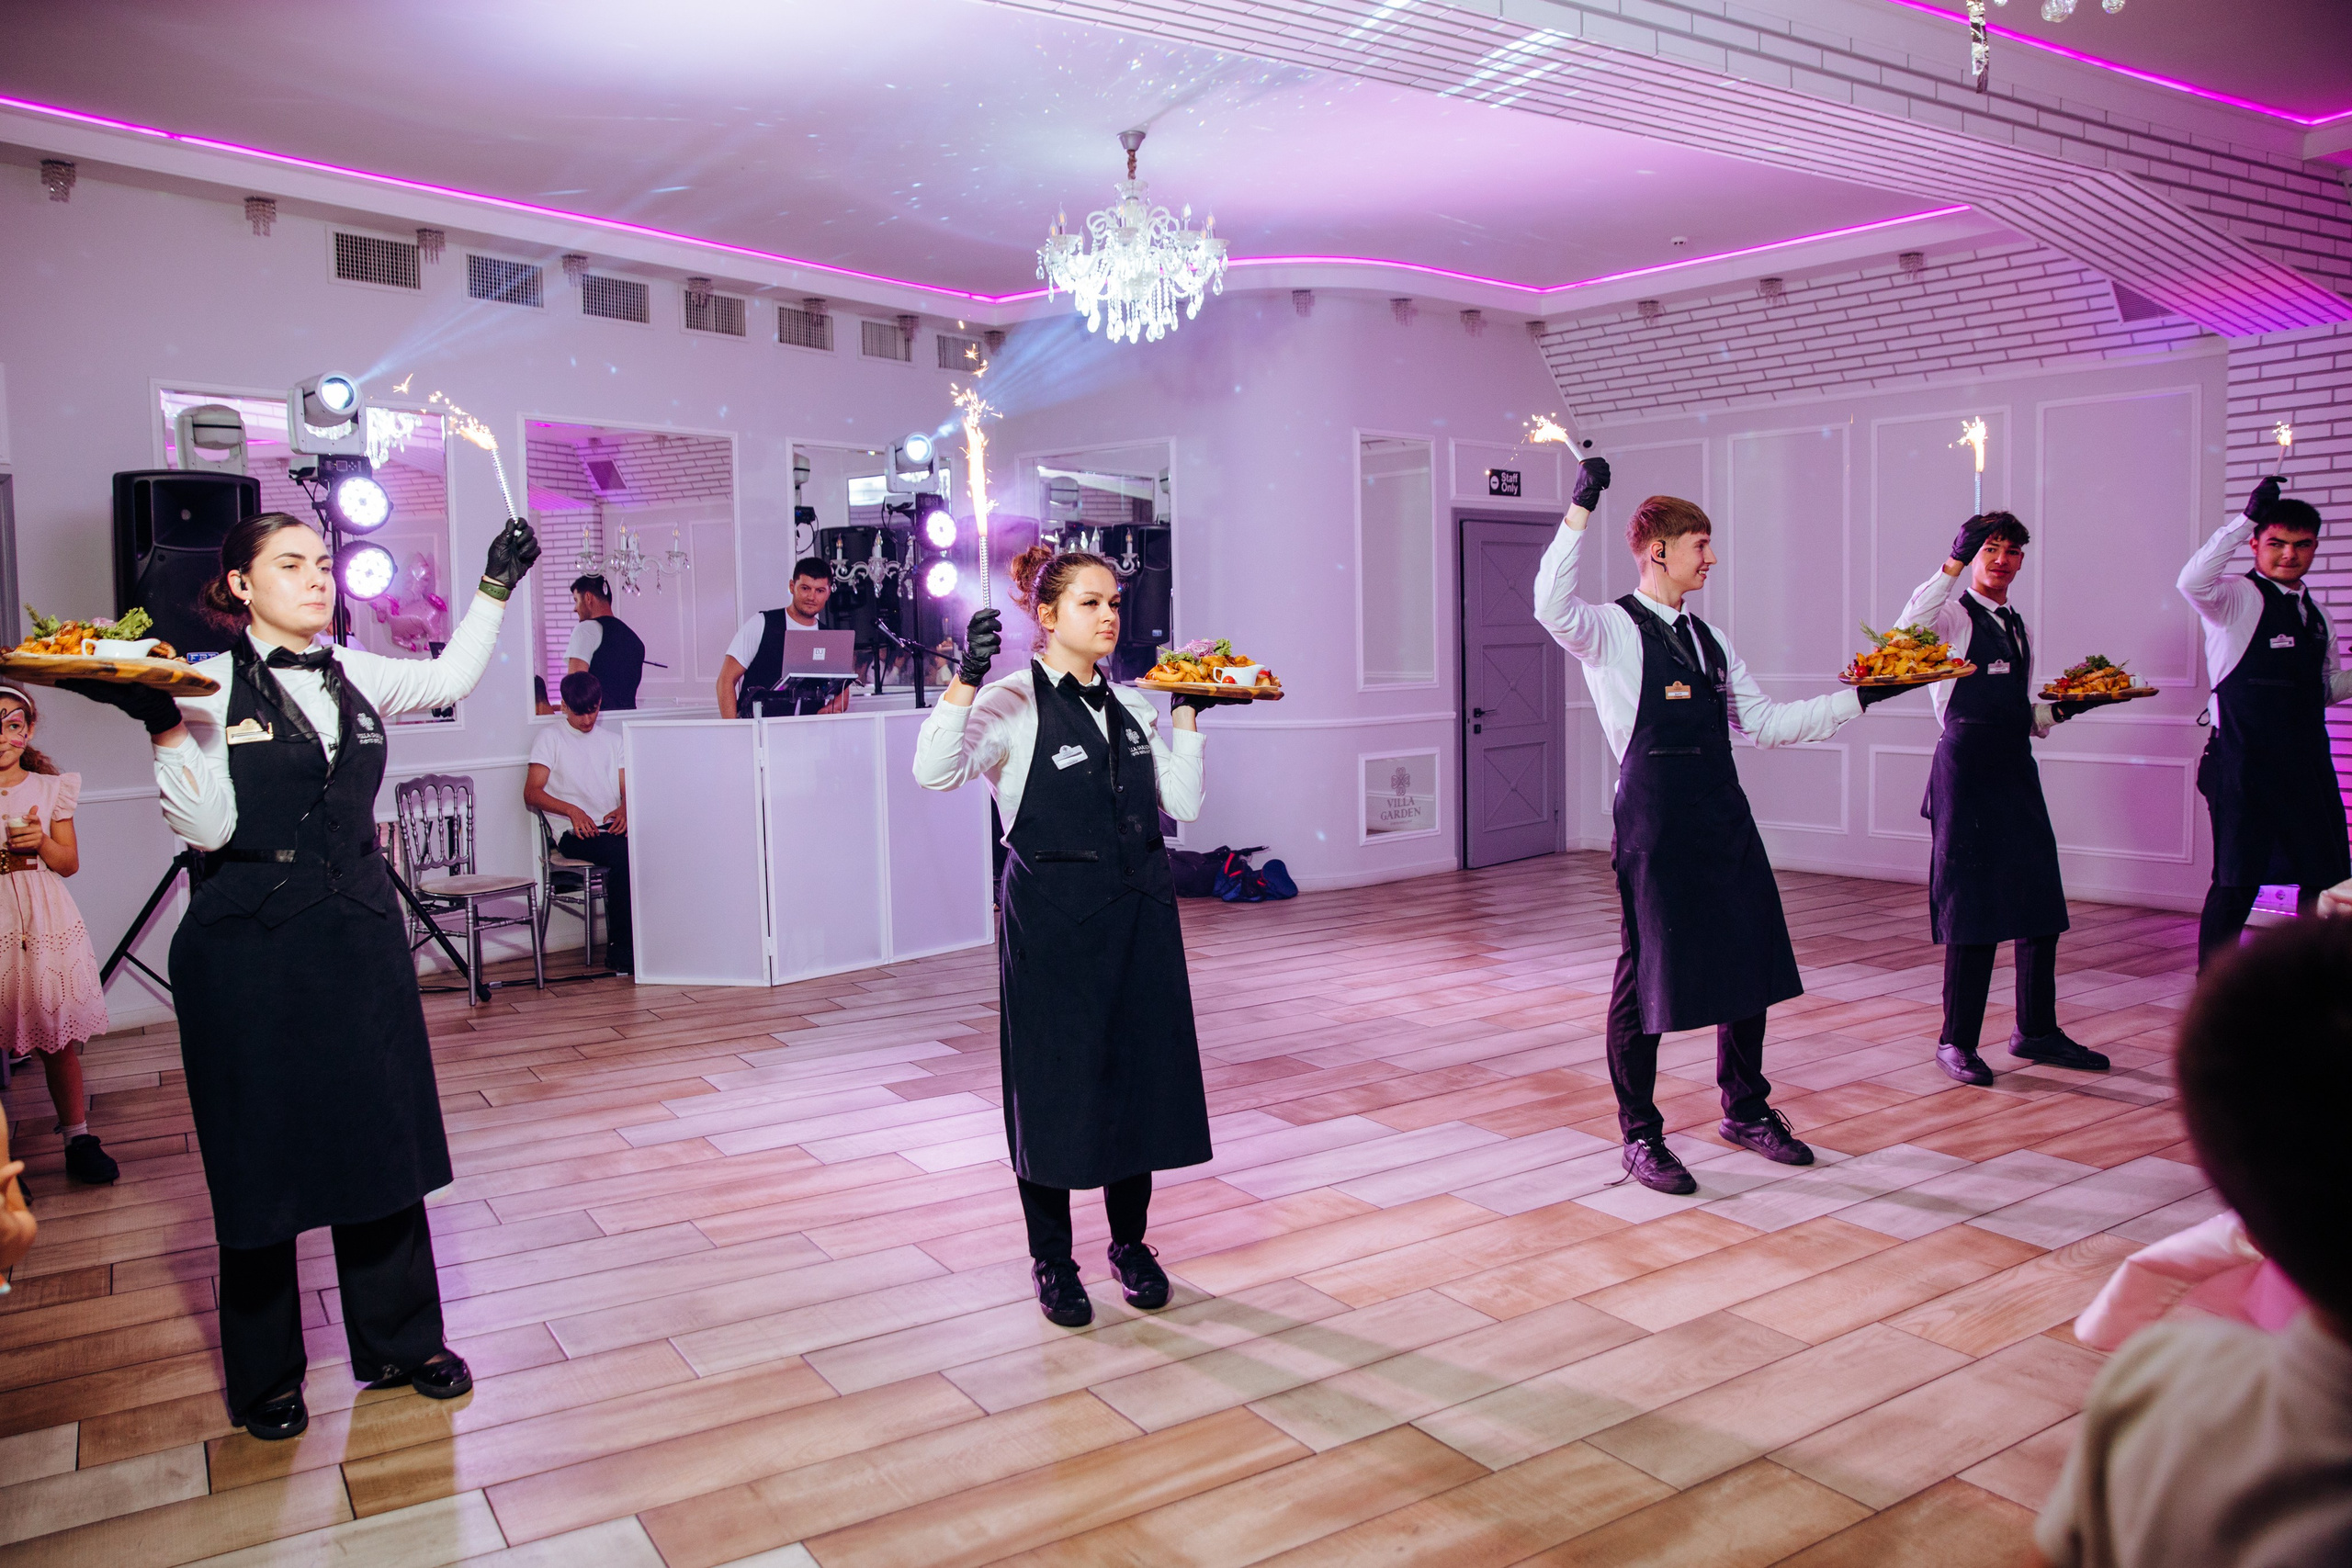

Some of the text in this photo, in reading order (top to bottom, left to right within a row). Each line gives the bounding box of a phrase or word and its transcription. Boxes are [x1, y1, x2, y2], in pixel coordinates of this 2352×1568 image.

[1501, 472, 1518, 483] Staff
[1501, 481, 1518, 495] Only
[1386, 796, 1415, 807] VILLA
[1380, 807, 1421, 820] GARDEN
